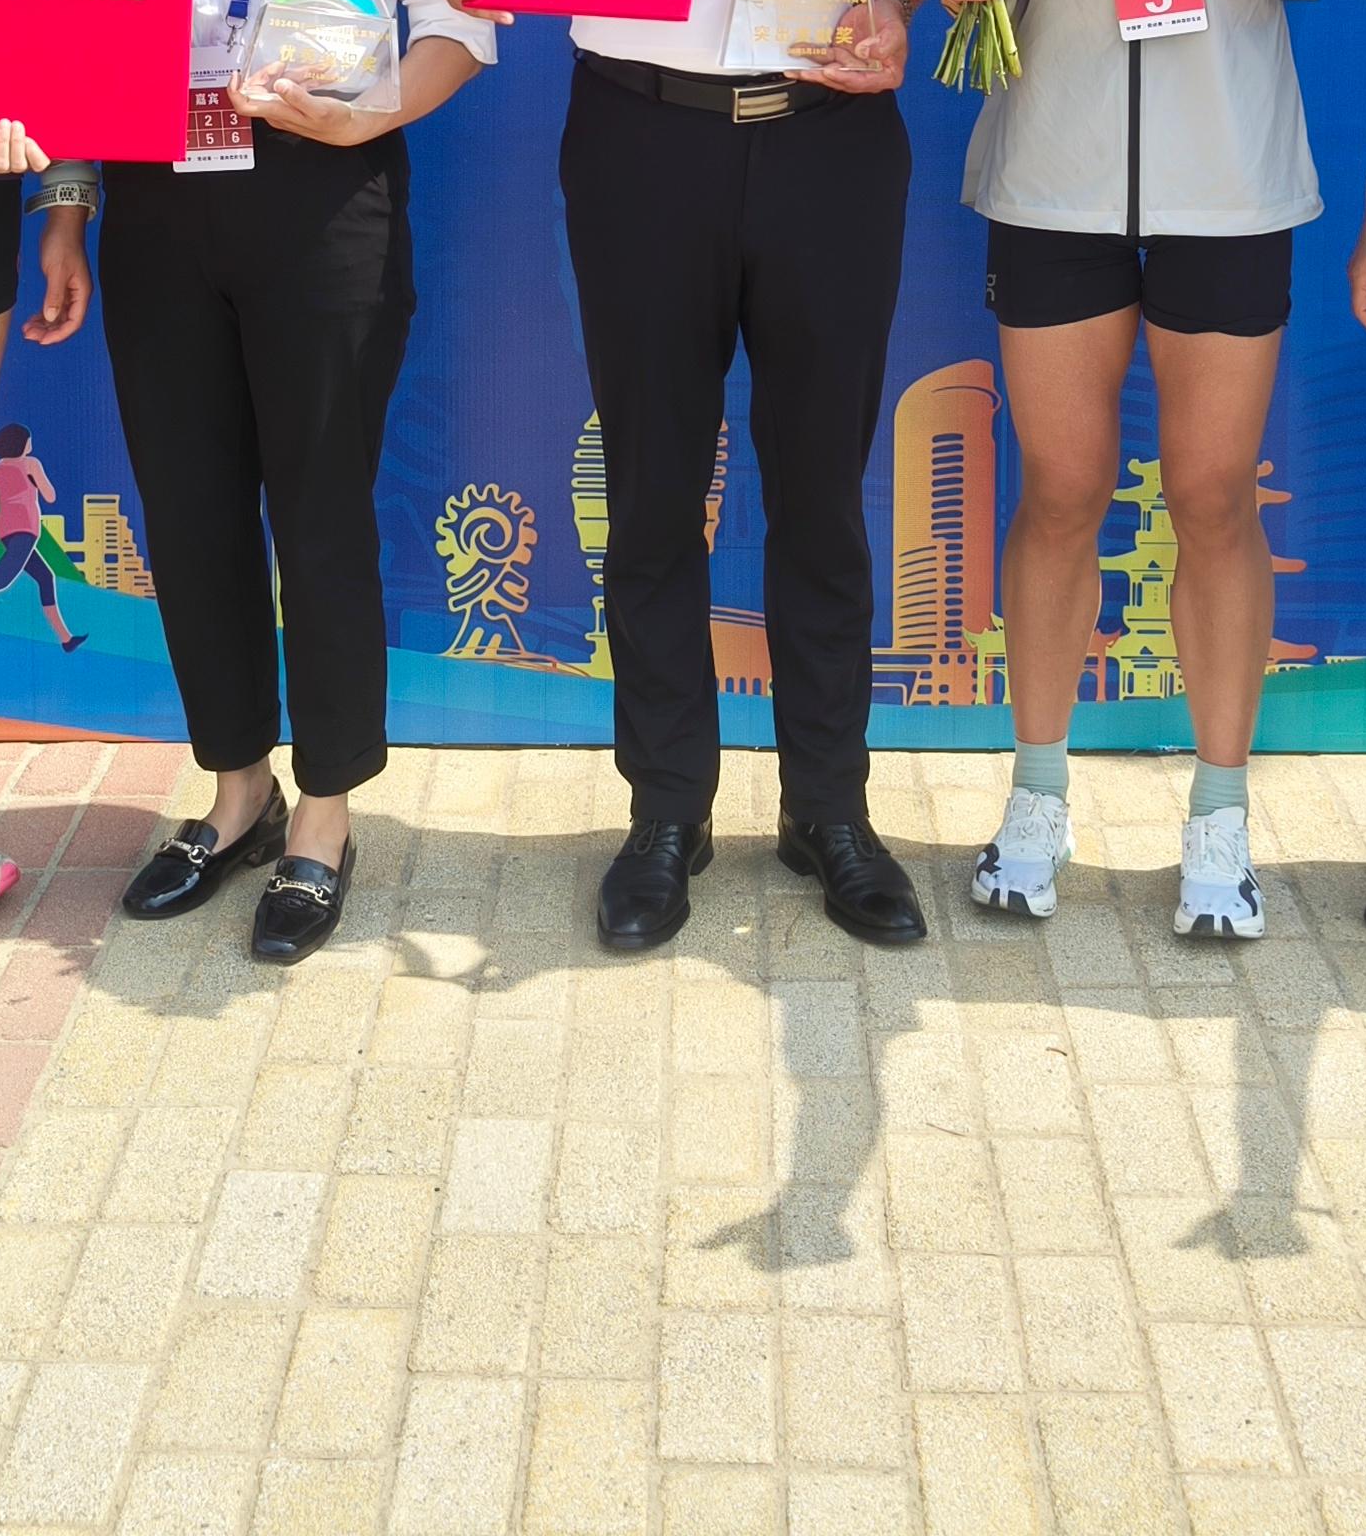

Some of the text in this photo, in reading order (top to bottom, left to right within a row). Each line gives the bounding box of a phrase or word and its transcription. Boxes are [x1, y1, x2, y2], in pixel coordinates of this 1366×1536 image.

[204, 113, 238, 127] 2 3
[205, 131, 240, 144] 5 6
